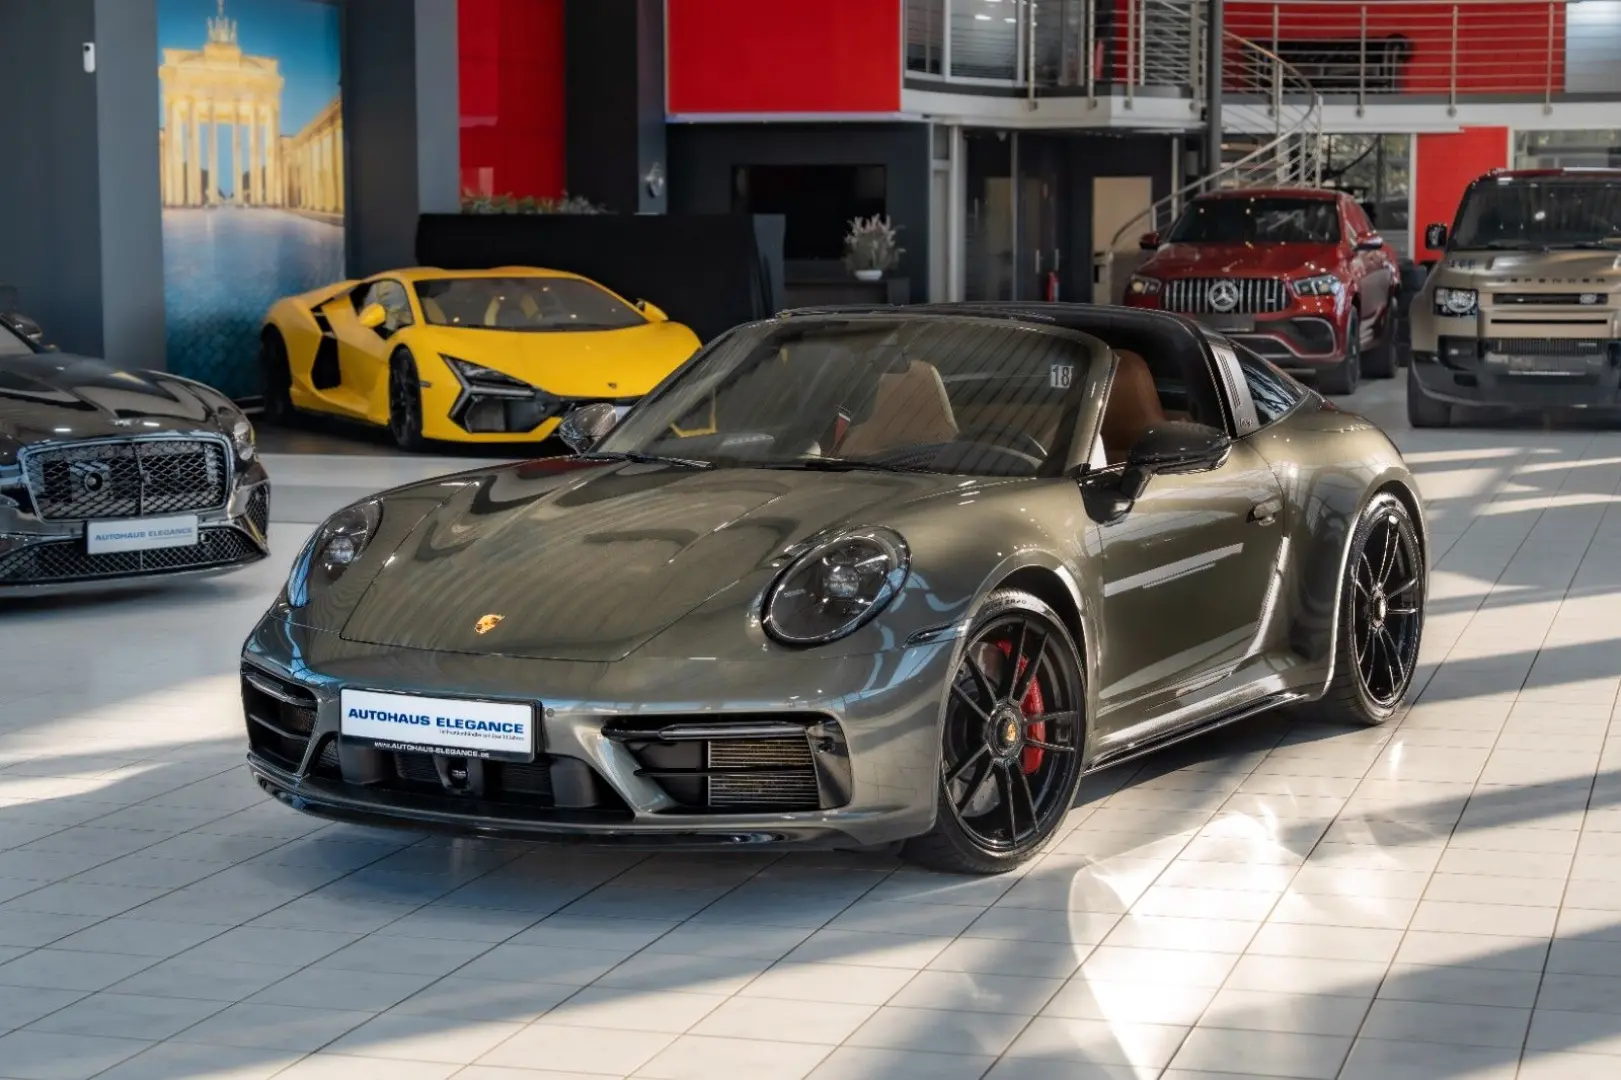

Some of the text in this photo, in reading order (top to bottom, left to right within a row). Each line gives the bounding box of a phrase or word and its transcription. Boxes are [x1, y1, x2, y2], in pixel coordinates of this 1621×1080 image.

[1052, 365, 1070, 387] 18
[94, 531, 146, 541] AUTOHAUS
[148, 527, 193, 537] ELEGANCE
[348, 708, 524, 734] AUTOHAUS ELEGANCE
